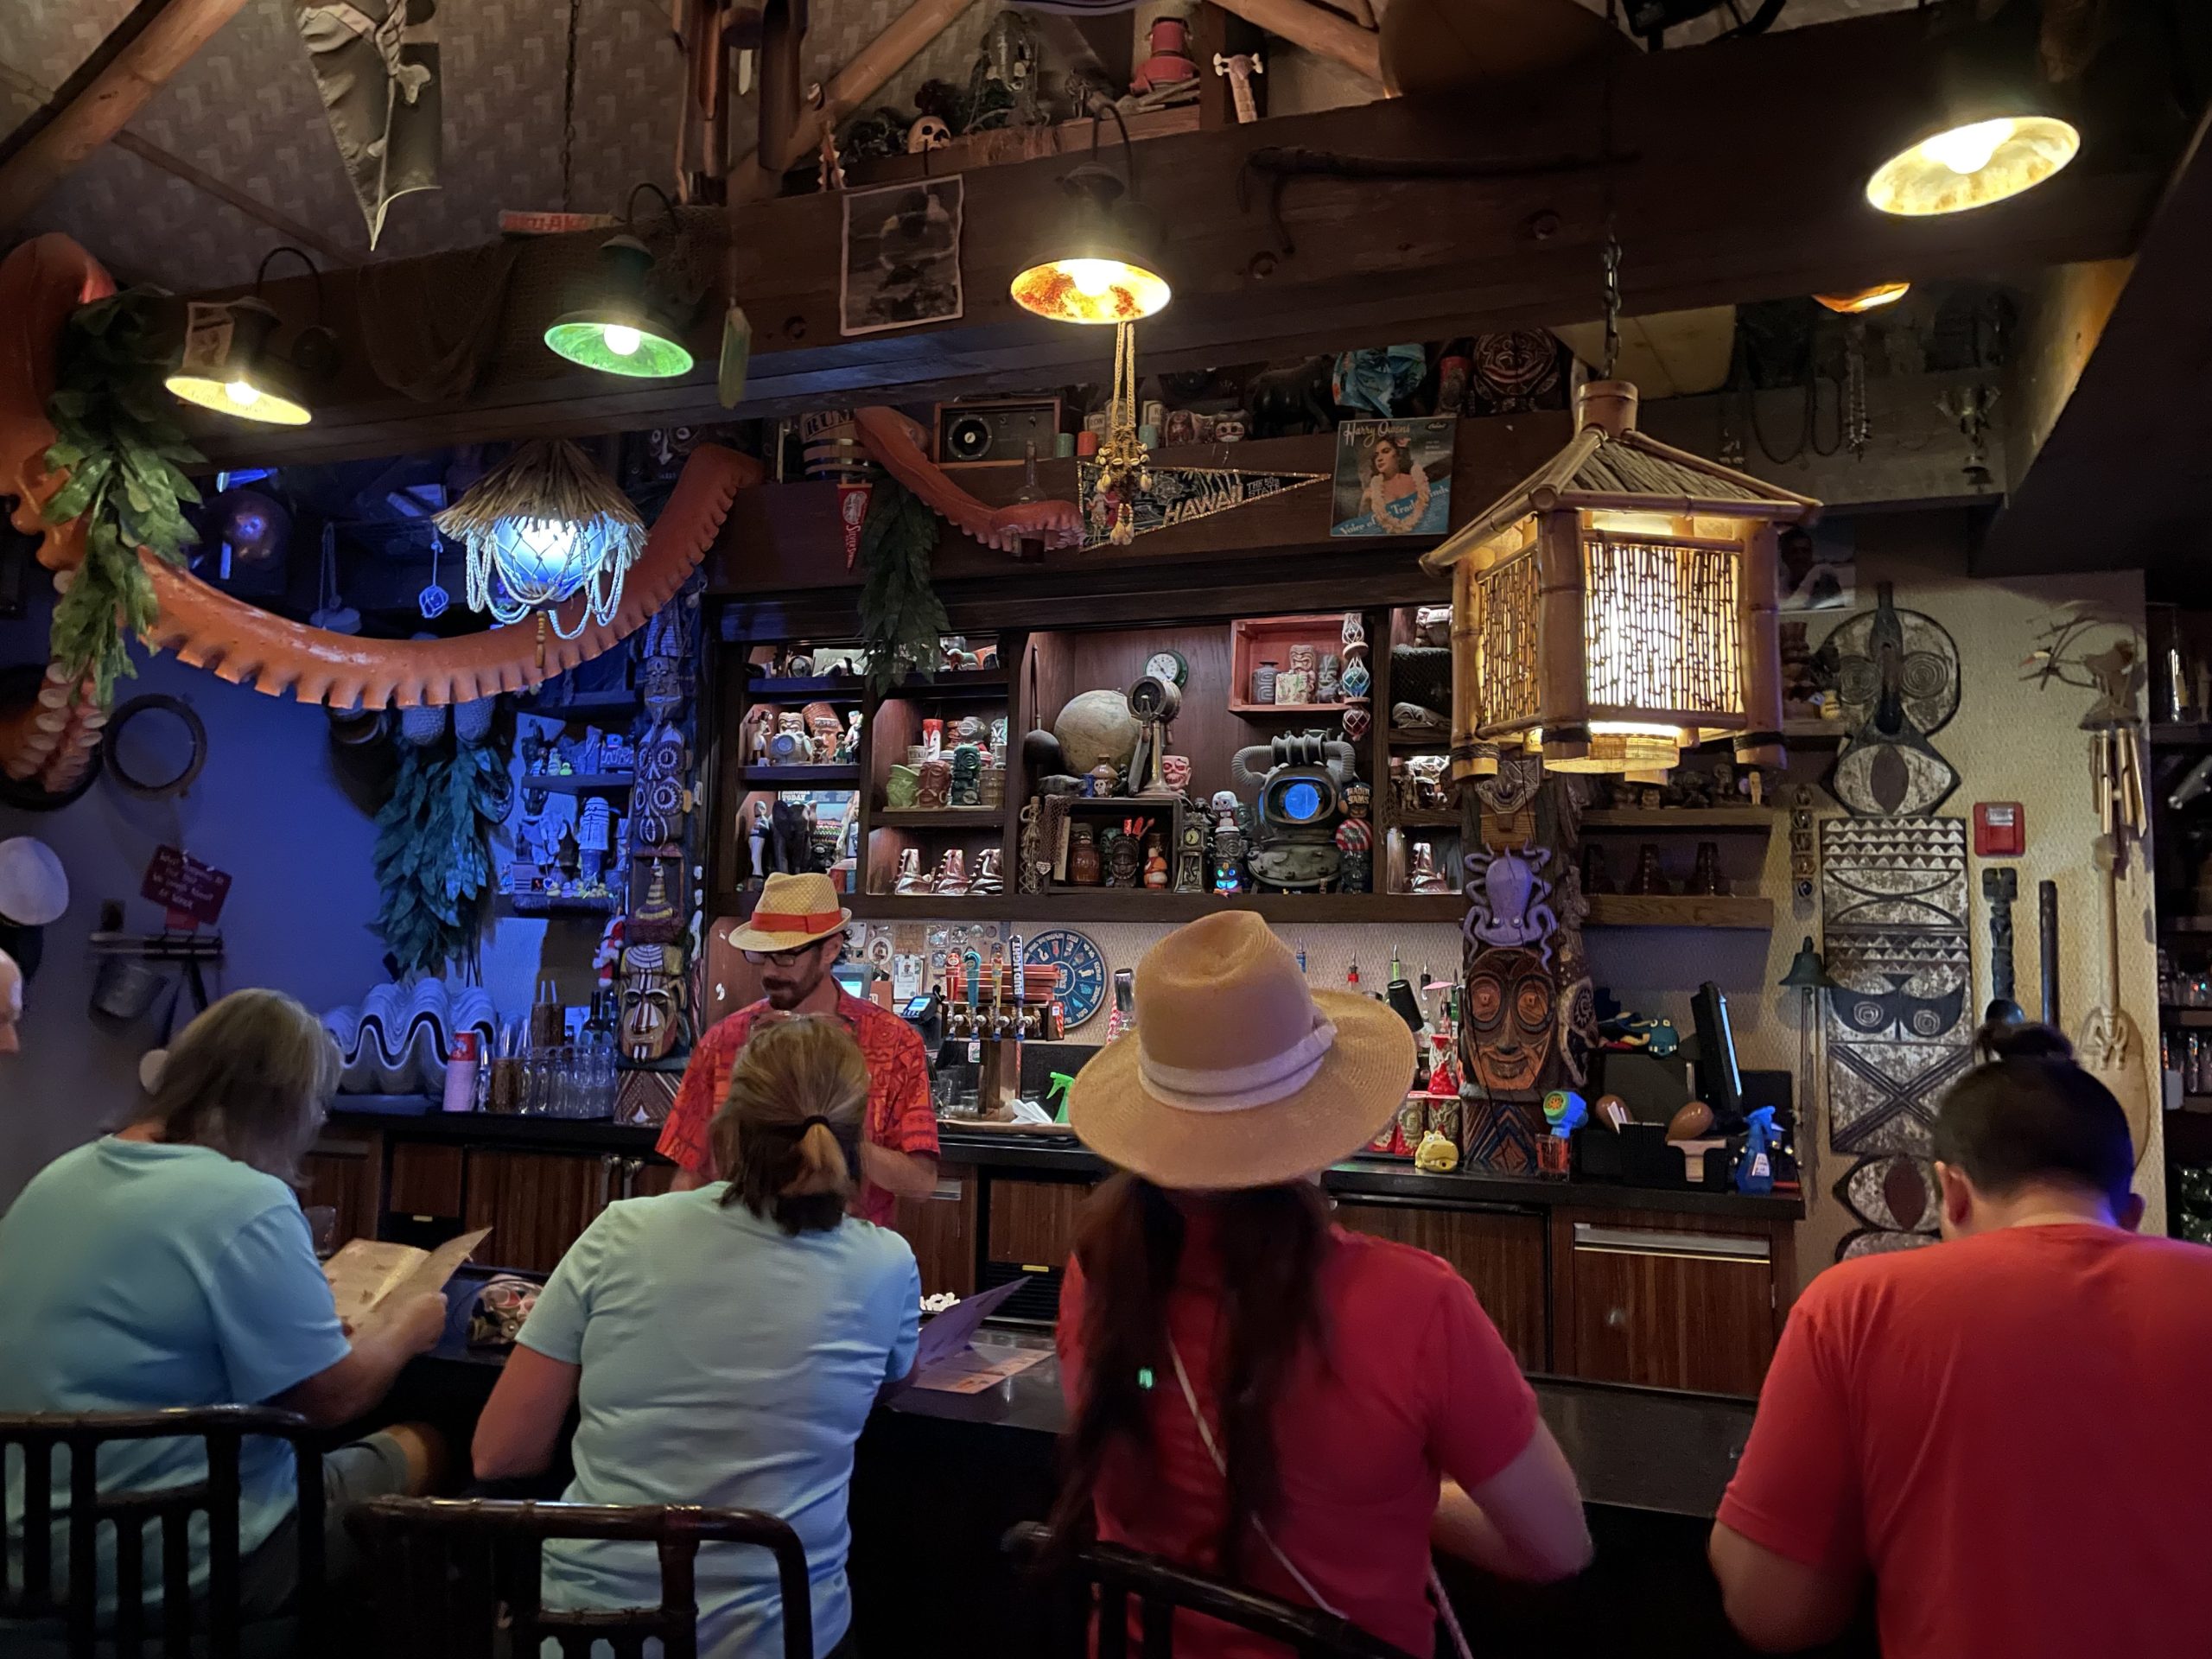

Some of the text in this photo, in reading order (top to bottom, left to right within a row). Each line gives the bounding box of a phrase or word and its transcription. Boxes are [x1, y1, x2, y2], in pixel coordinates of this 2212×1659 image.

[1343, 420, 1376, 448] Harry
[1247, 479, 1264, 490] THE
[1248, 482, 1281, 498] STATE
[1162, 483, 1243, 525] HAWAII
[1339, 522, 1365, 536] Voice
[1367, 516, 1376, 527] of
[1390, 499, 1416, 515] Trad
[1345, 787, 1370, 796] TRADER
[1012, 941, 1023, 995] BUD LIGHT
